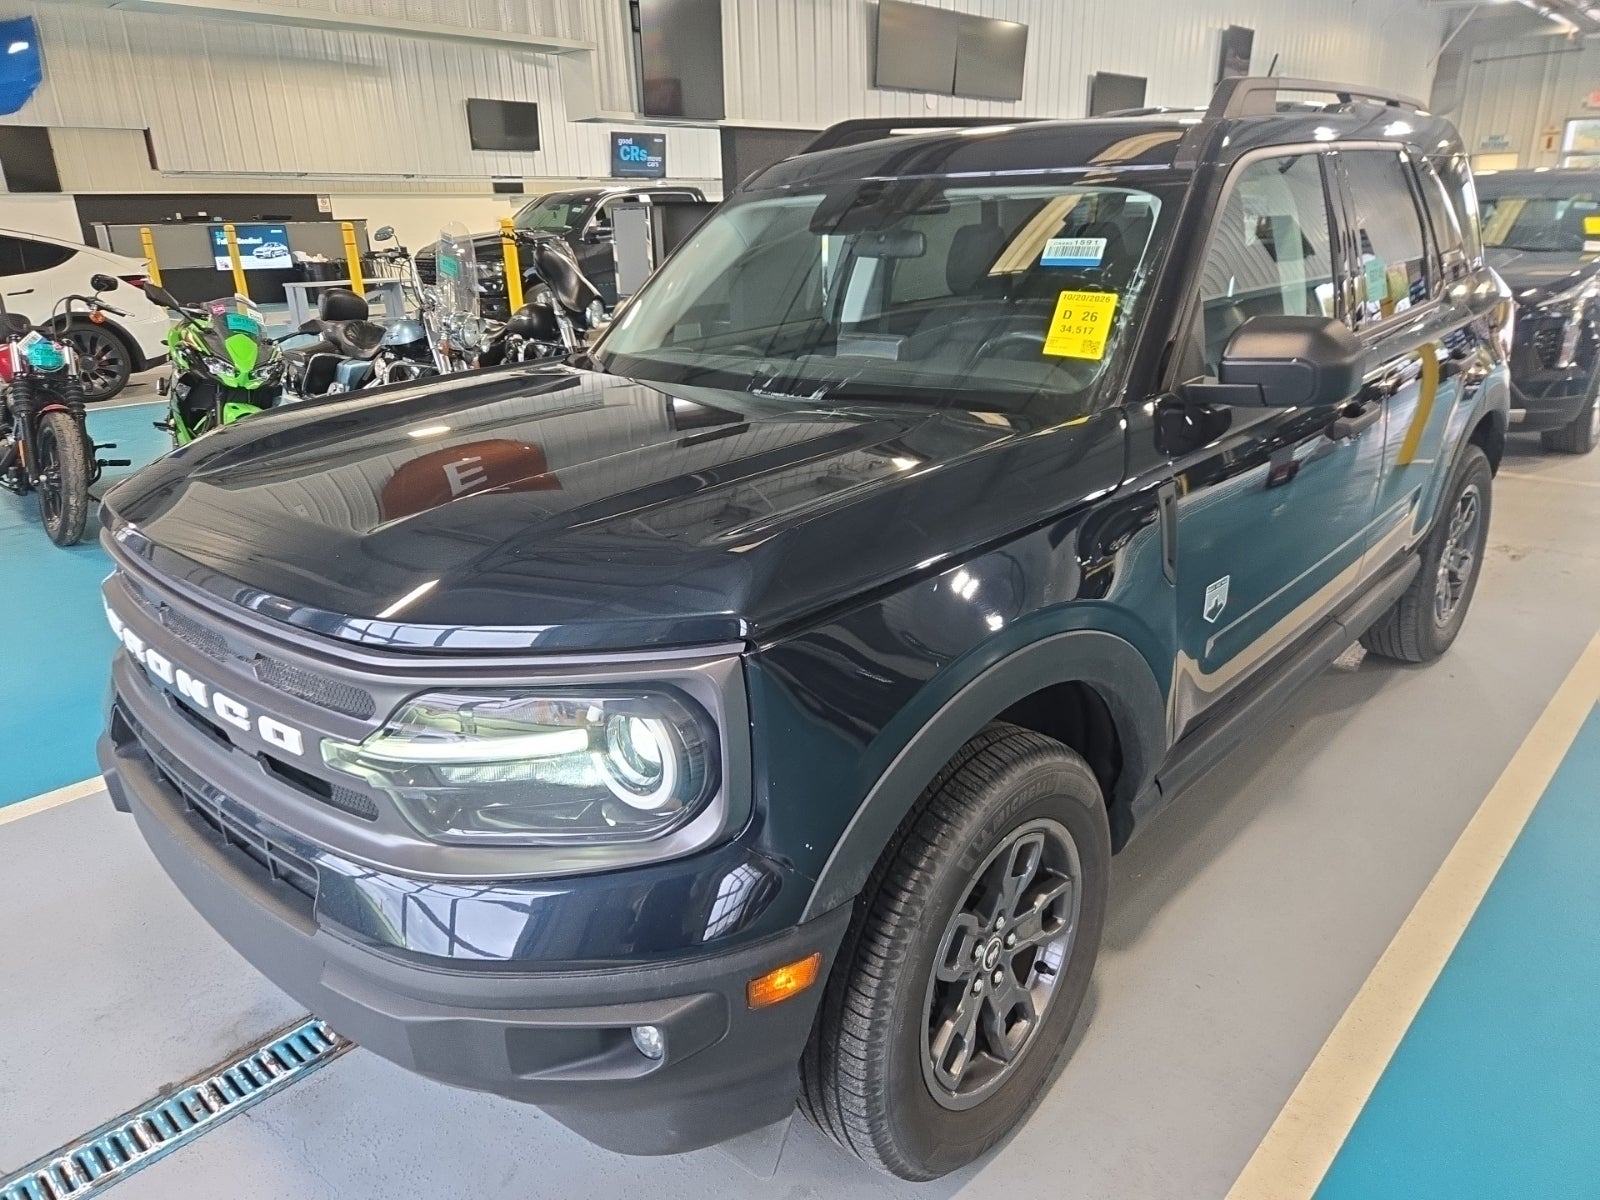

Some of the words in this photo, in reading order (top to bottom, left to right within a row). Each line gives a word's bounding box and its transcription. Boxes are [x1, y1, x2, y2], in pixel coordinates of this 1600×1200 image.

[617, 138, 633, 146] good
[620, 145, 648, 161] CRs
[1063, 310, 1072, 320] D
[1081, 311, 1099, 322] 26
[1059, 325, 1095, 335] 34,517
